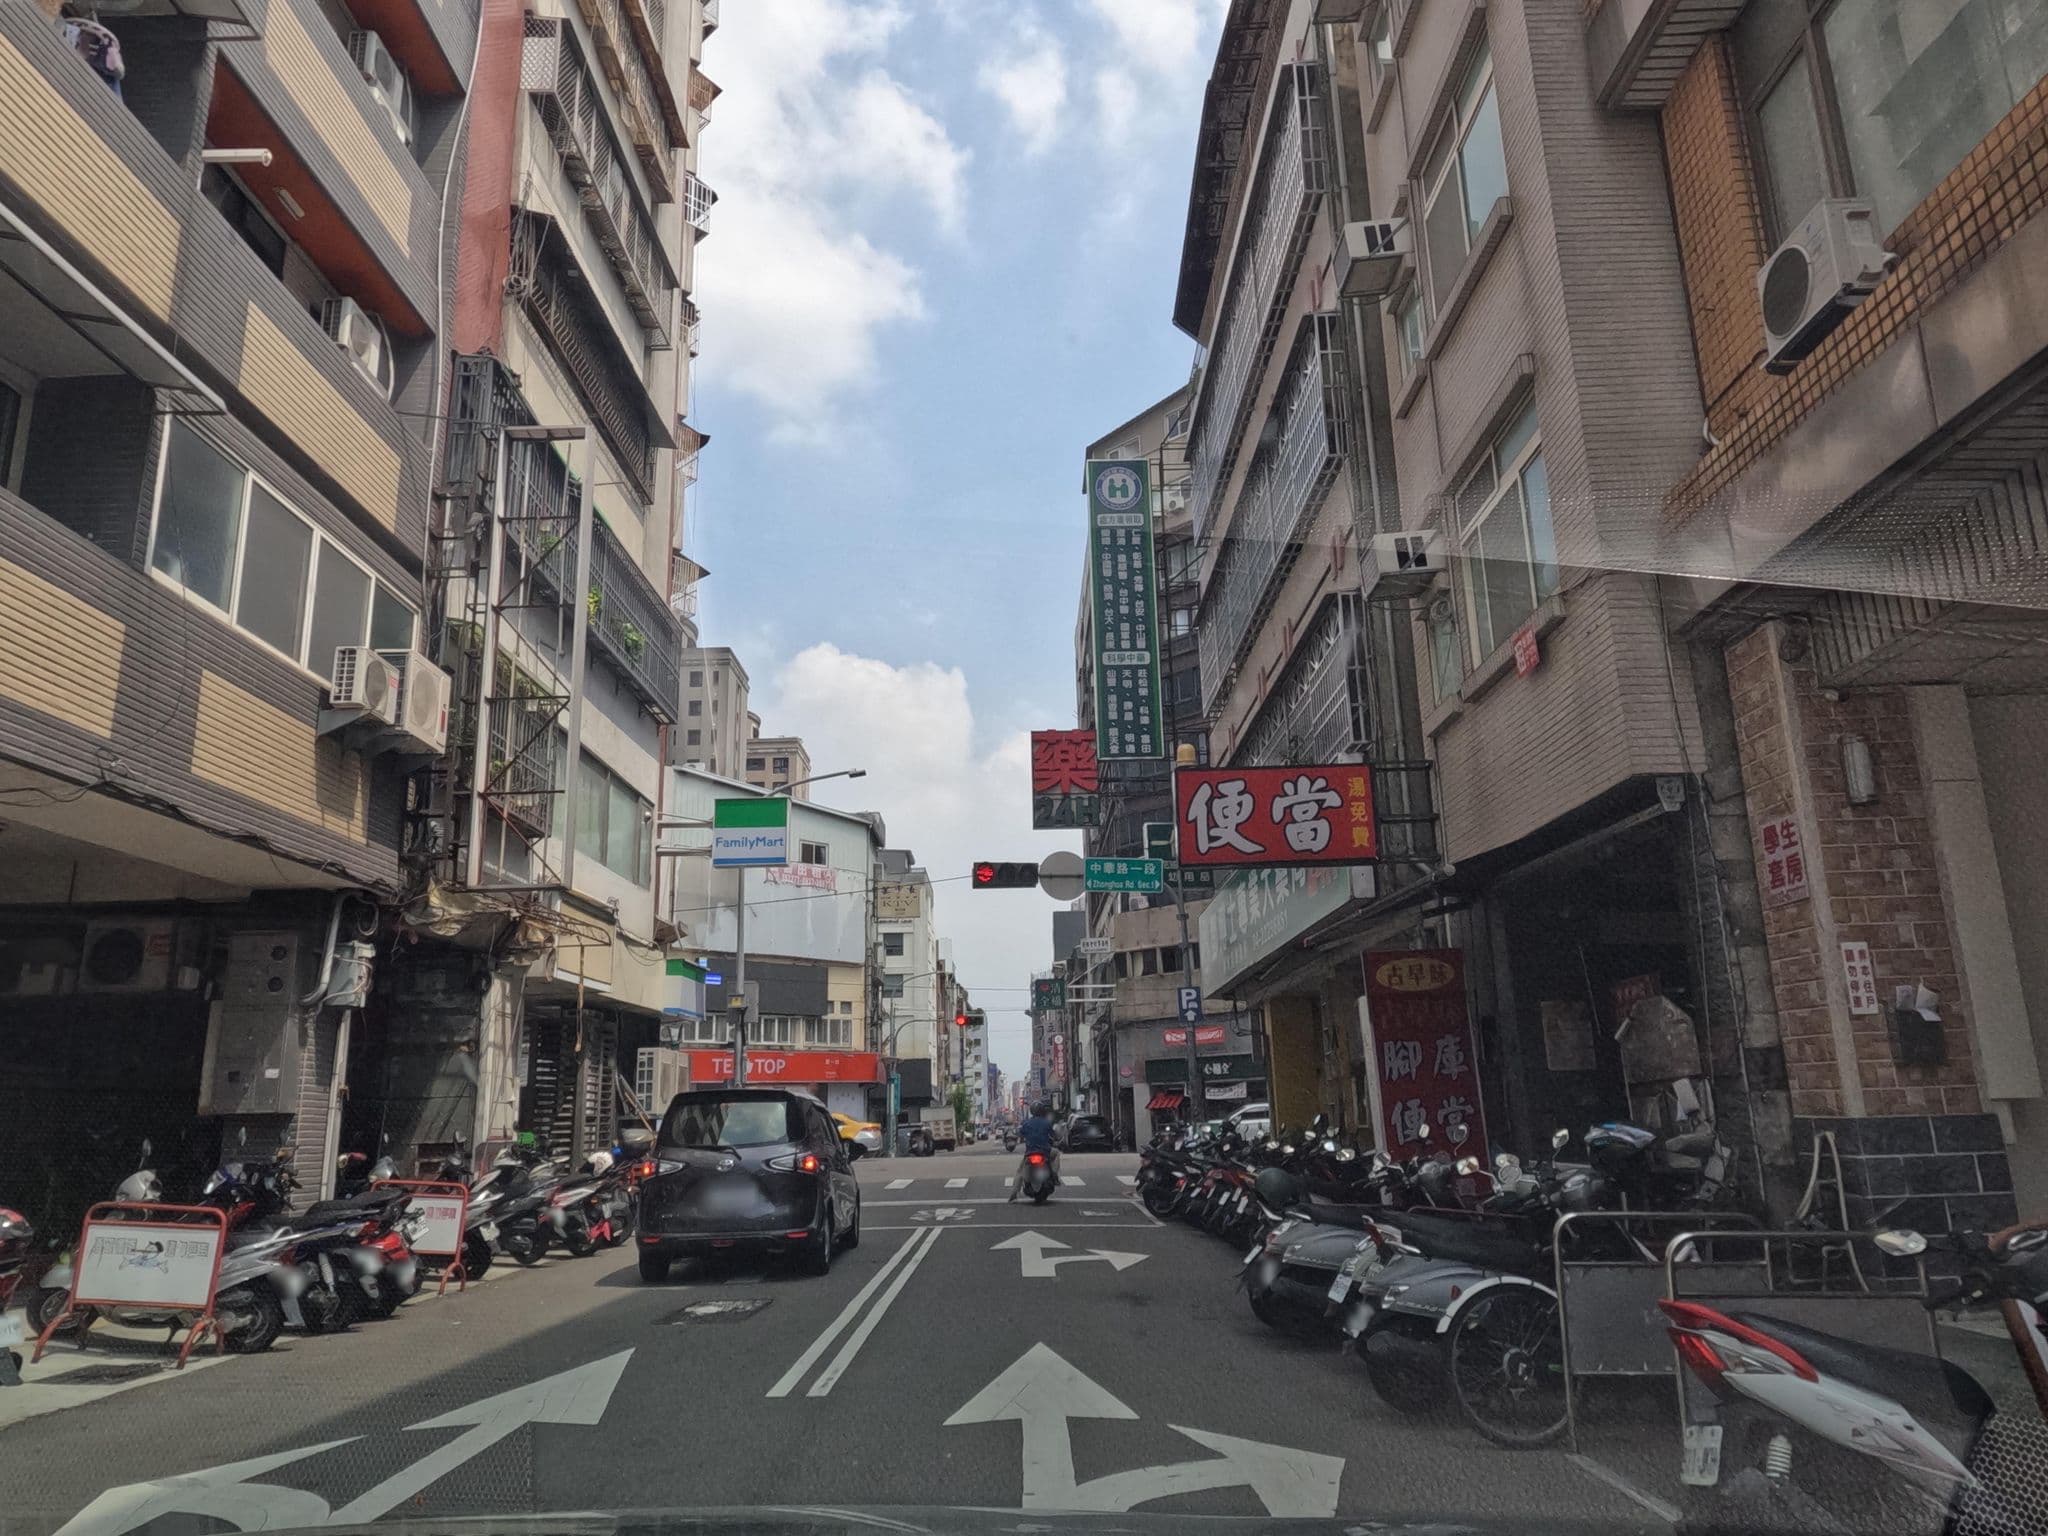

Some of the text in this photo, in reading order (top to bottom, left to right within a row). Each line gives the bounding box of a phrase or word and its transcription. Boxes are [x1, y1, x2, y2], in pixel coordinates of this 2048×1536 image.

[1033, 729, 1100, 794] 藥
[1034, 796, 1100, 826] 24H
[1187, 774, 1344, 855] 便當
[1347, 776, 1370, 848] 湯免費
[715, 835, 784, 849] FamilyMart
[1763, 821, 1799, 855] 學生
[1090, 862, 1157, 875] 中華路一段
[1092, 880, 1123, 890] Zhonghua
[1768, 853, 1803, 890] 套房
[1181, 989, 1197, 1009] P
[755, 1058, 786, 1074] TOP
[1383, 1034, 1470, 1081] 腳庫
[1390, 1096, 1475, 1145] 便當
